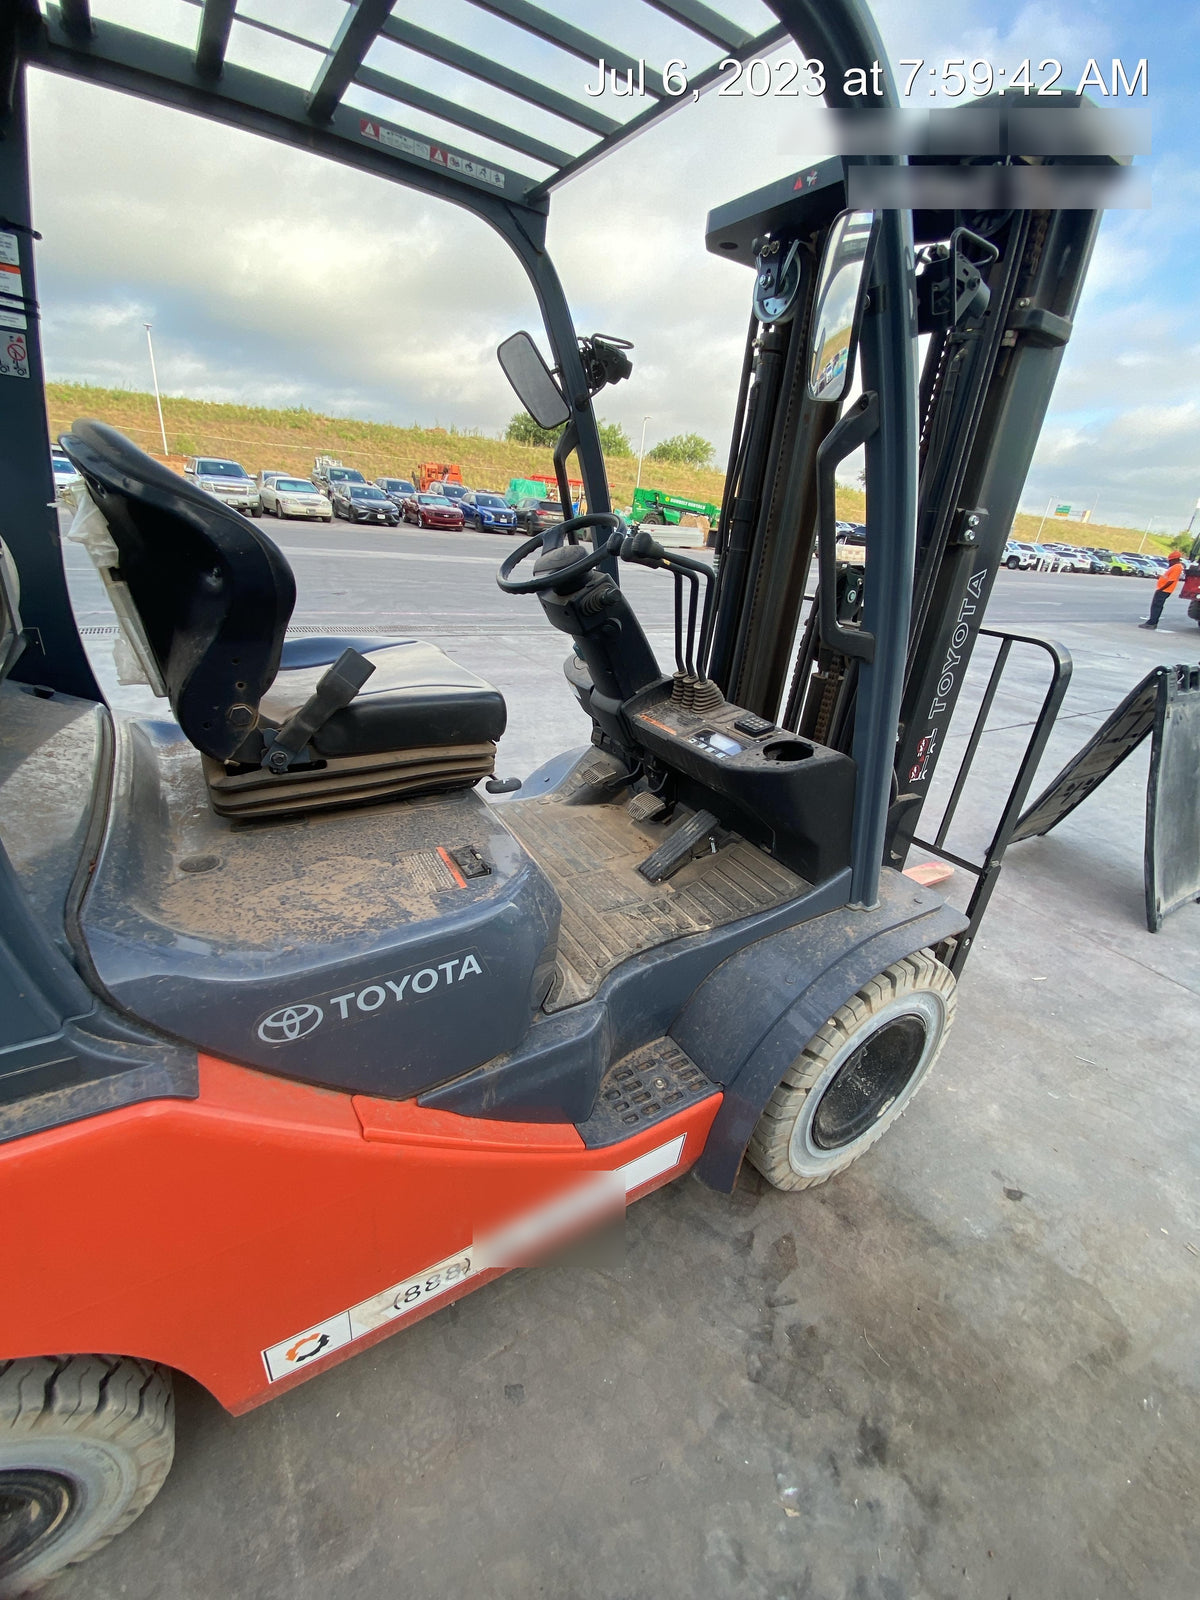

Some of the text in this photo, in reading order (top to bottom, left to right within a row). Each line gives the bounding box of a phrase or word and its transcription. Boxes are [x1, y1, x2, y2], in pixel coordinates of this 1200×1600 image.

[928, 568, 988, 720] TOYOTA
[329, 954, 483, 1020] TOYOTA
[393, 1257, 471, 1310] (888)
